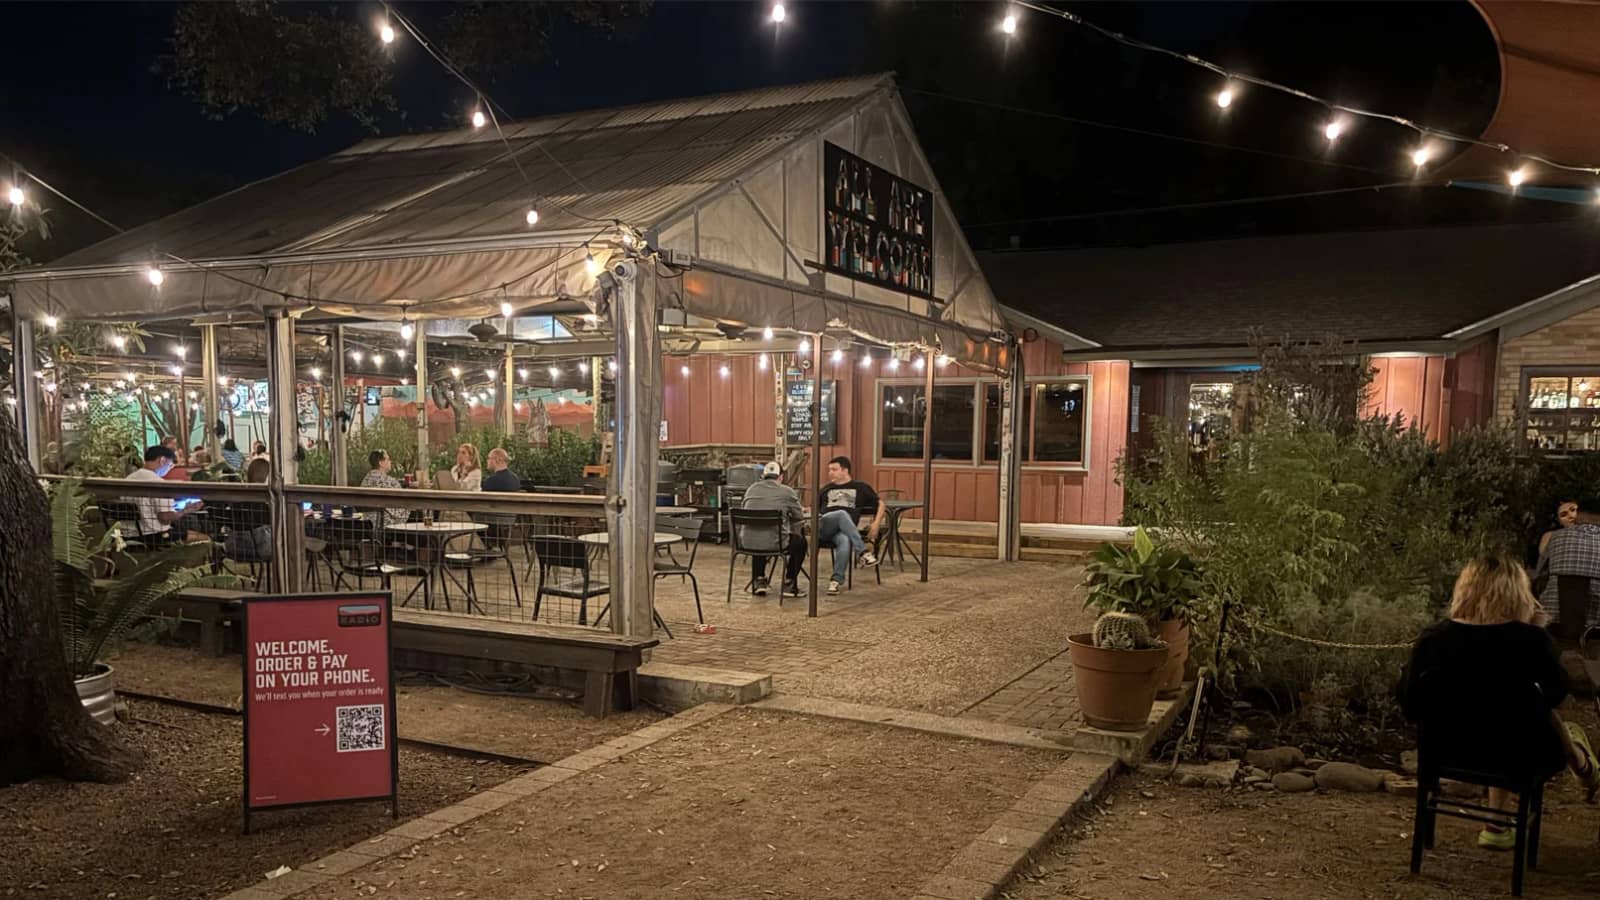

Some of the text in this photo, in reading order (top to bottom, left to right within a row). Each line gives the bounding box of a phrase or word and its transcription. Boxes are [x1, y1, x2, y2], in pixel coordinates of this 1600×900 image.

[256, 640, 334, 656] WELCOME,
[255, 654, 348, 672] ORDER & PAY
[255, 669, 376, 688] ON YOUR PHONE.
[255, 687, 384, 701] We'll text you when your order is ready
